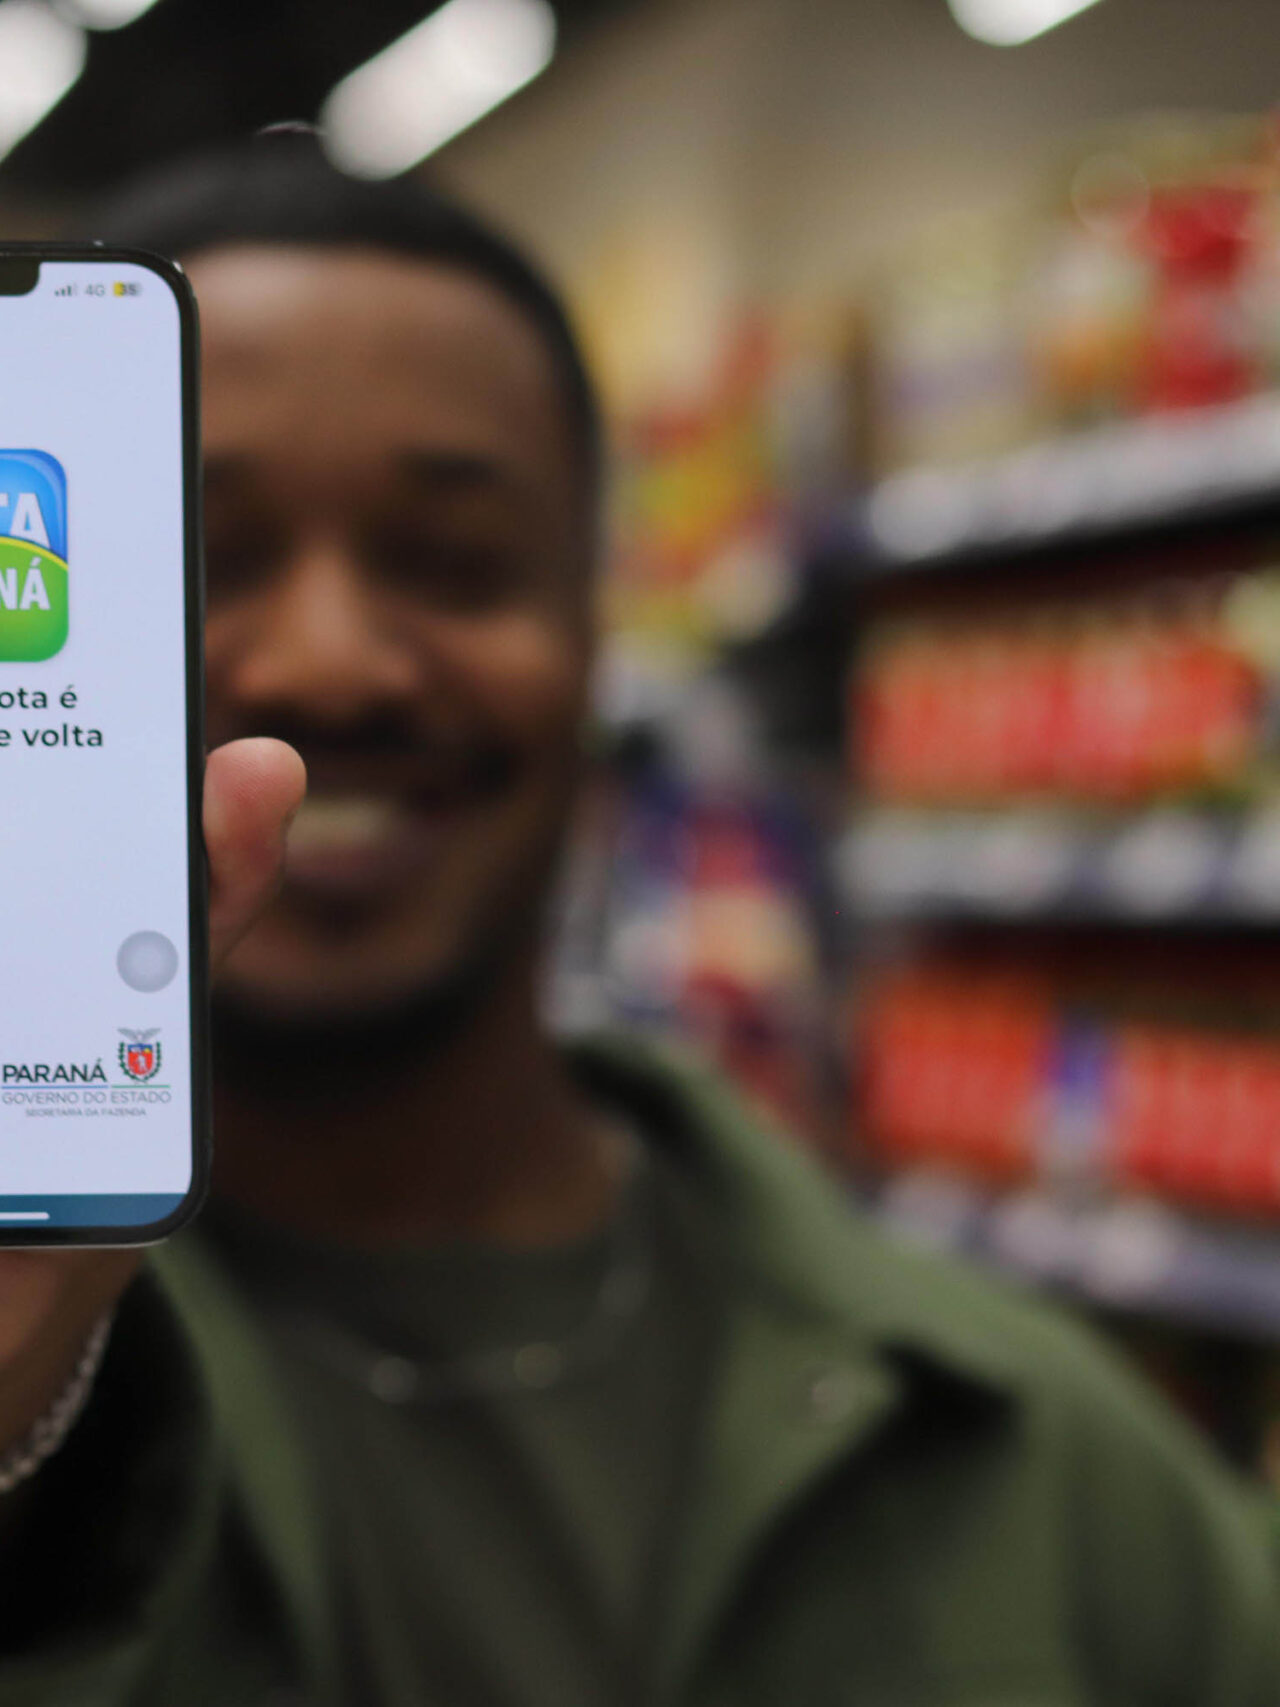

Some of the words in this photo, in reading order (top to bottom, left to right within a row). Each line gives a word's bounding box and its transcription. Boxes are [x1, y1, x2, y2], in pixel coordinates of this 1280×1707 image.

[84, 284, 105, 297] 4G
[59, 685, 78, 709] é
[22, 723, 103, 747] volta
[2, 1057, 108, 1083] PARANÁ
[1, 1091, 79, 1105] GOVERNO
[83, 1091, 106, 1105] DO
[110, 1091, 172, 1105] ESTADO
